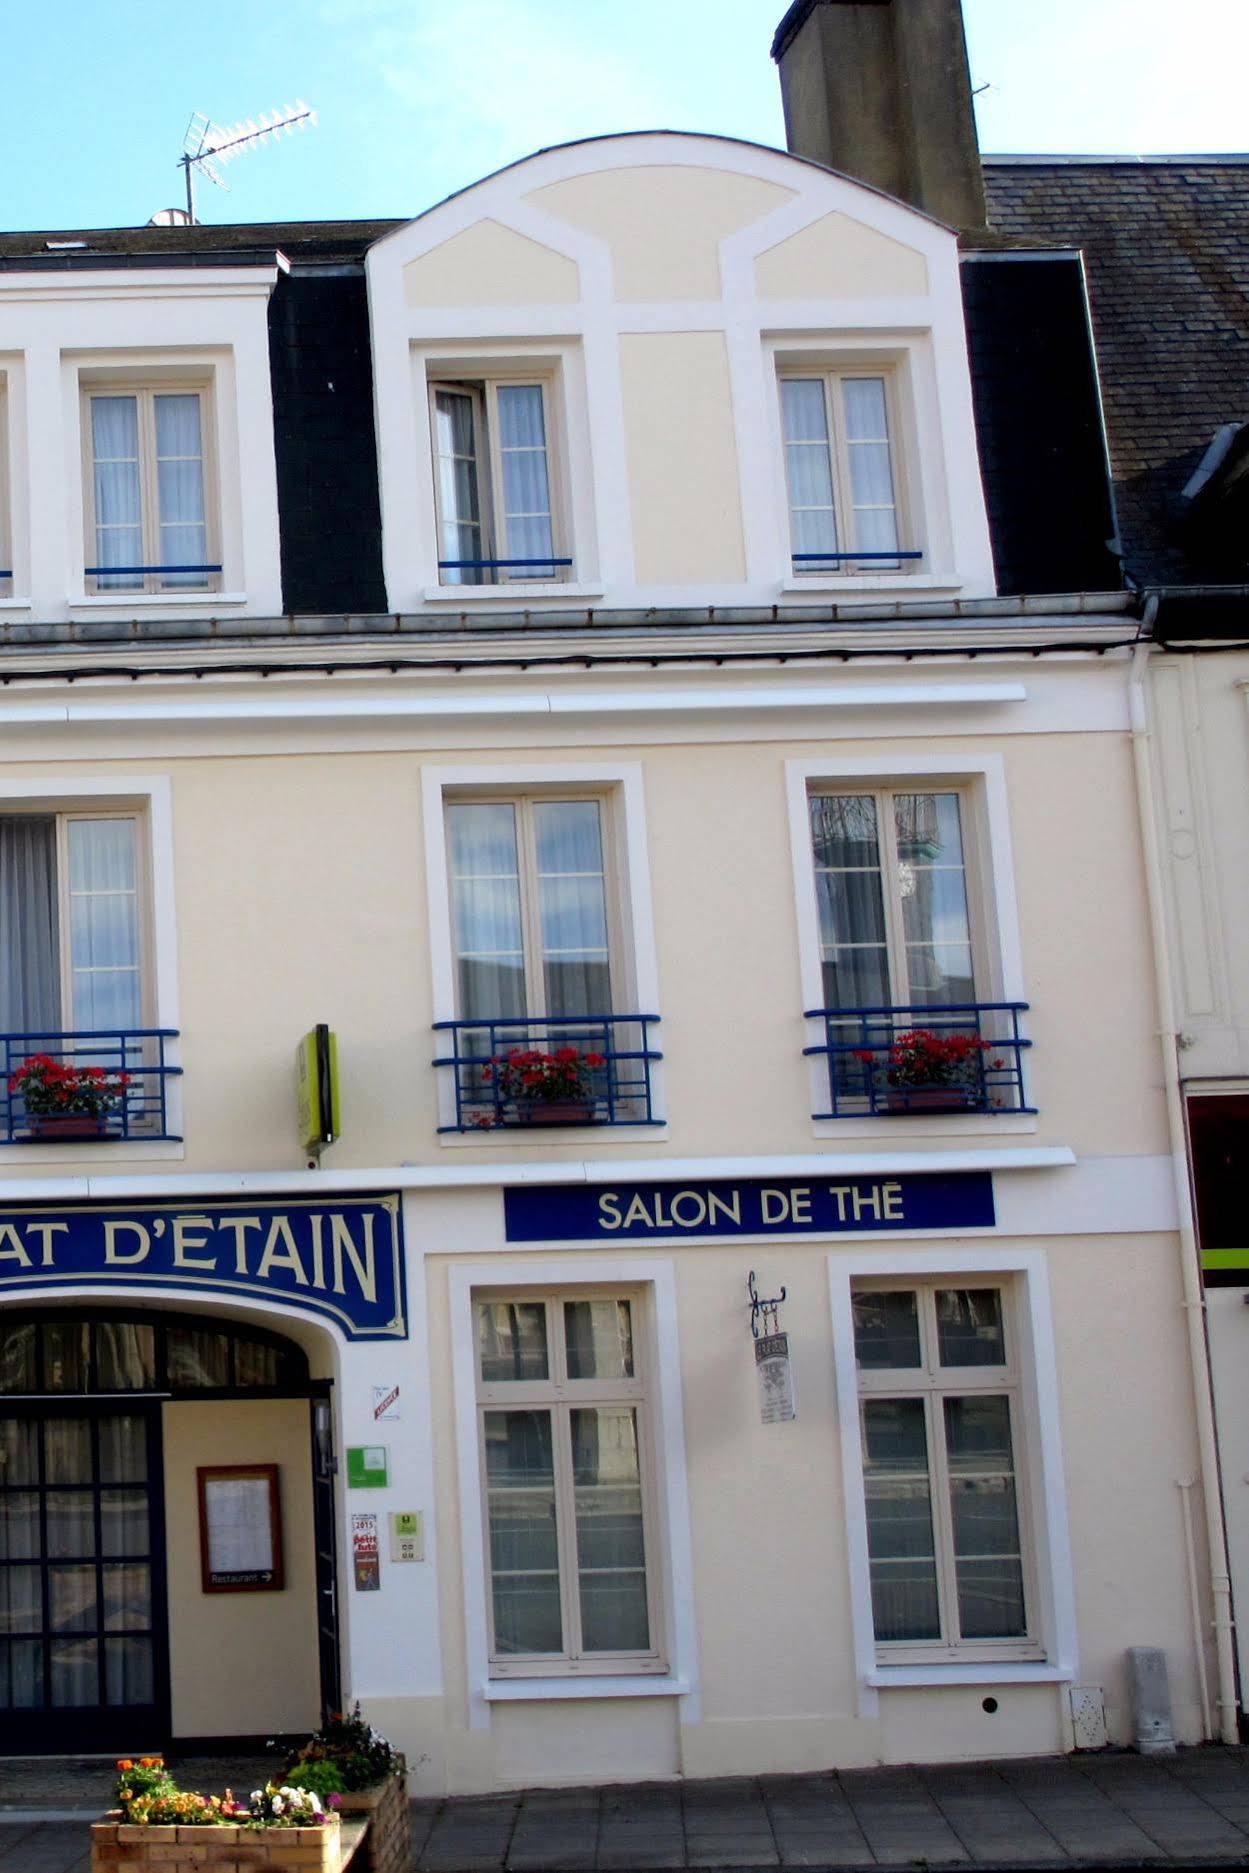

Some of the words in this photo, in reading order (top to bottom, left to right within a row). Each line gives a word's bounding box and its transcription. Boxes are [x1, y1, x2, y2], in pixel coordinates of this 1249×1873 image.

[598, 1190, 741, 1229] SALON
[761, 1188, 812, 1224] DE
[355, 1521, 374, 1530] 2015
